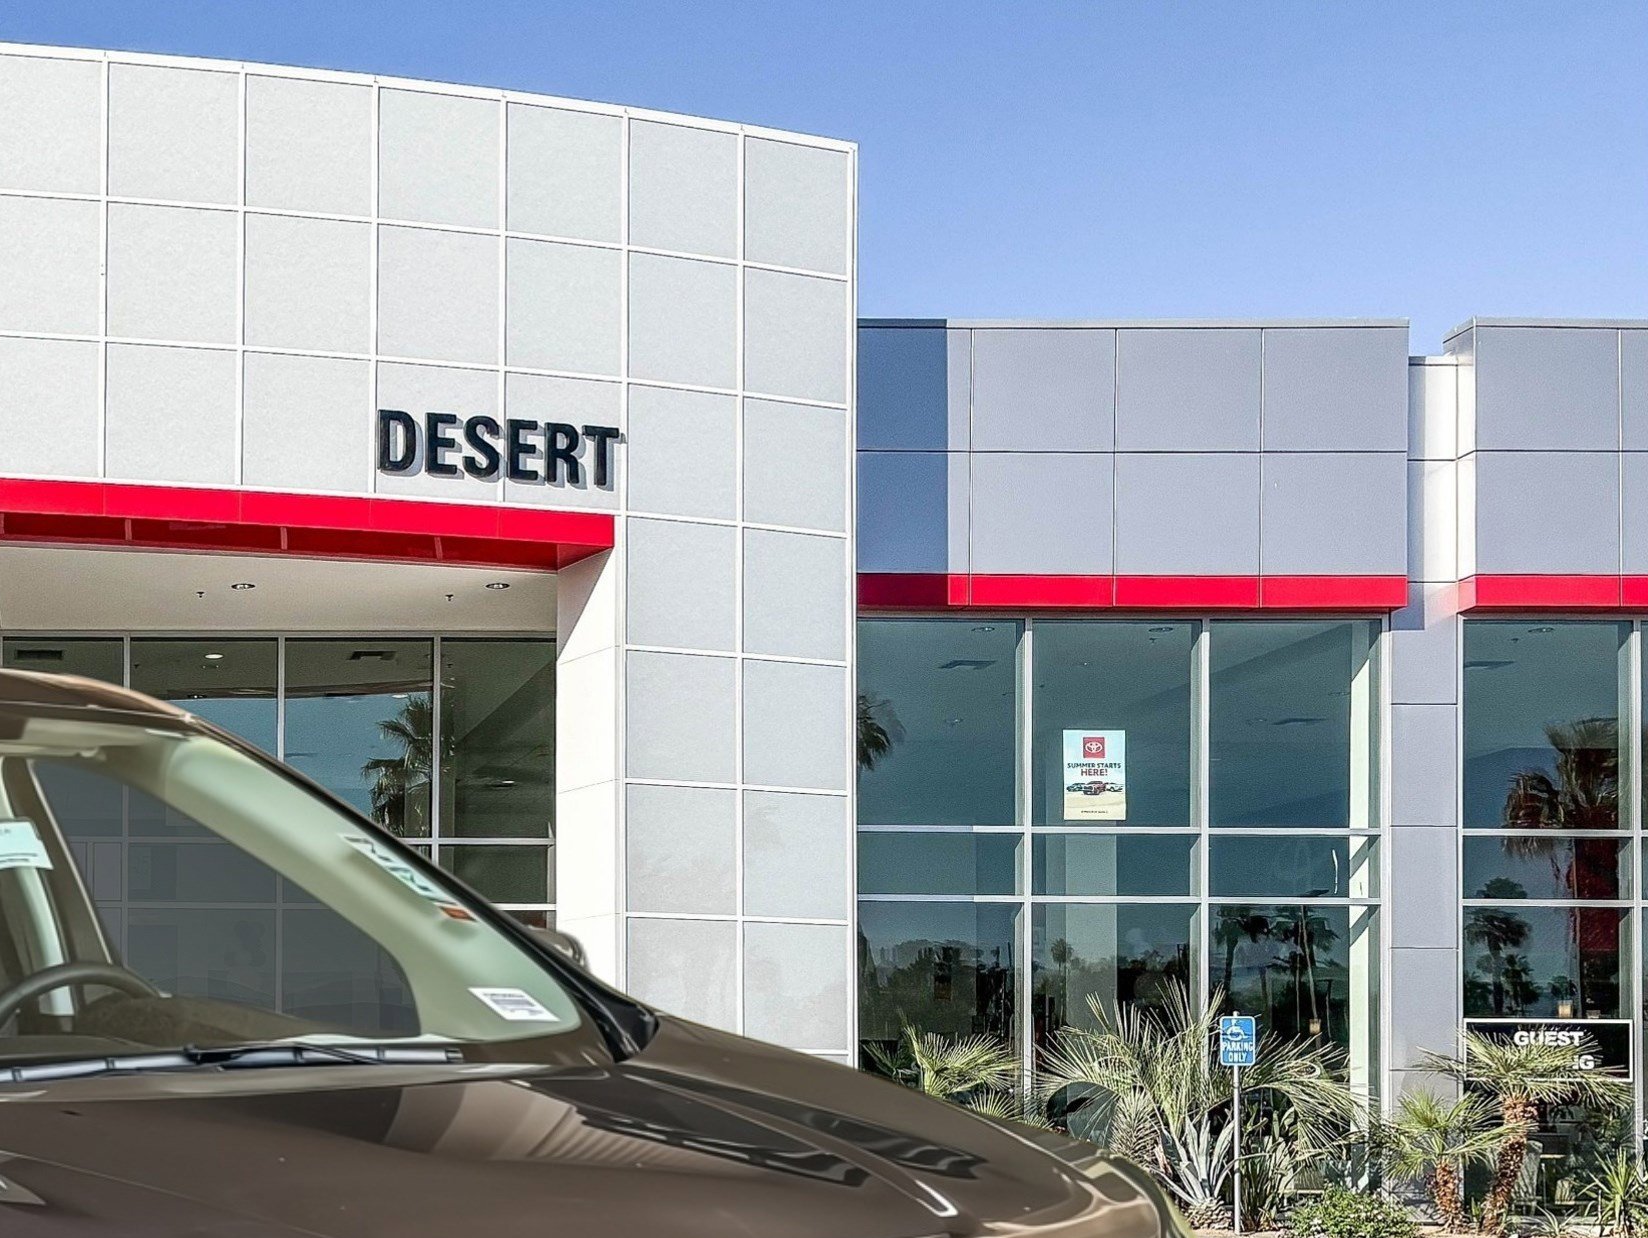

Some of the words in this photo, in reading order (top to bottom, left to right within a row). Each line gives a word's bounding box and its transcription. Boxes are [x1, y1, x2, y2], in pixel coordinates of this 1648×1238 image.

[377, 409, 619, 486] DESERT
[1513, 1030, 1584, 1046] GUEST
[1222, 1041, 1254, 1051] PARKING
[1228, 1052, 1248, 1062] ONLY
